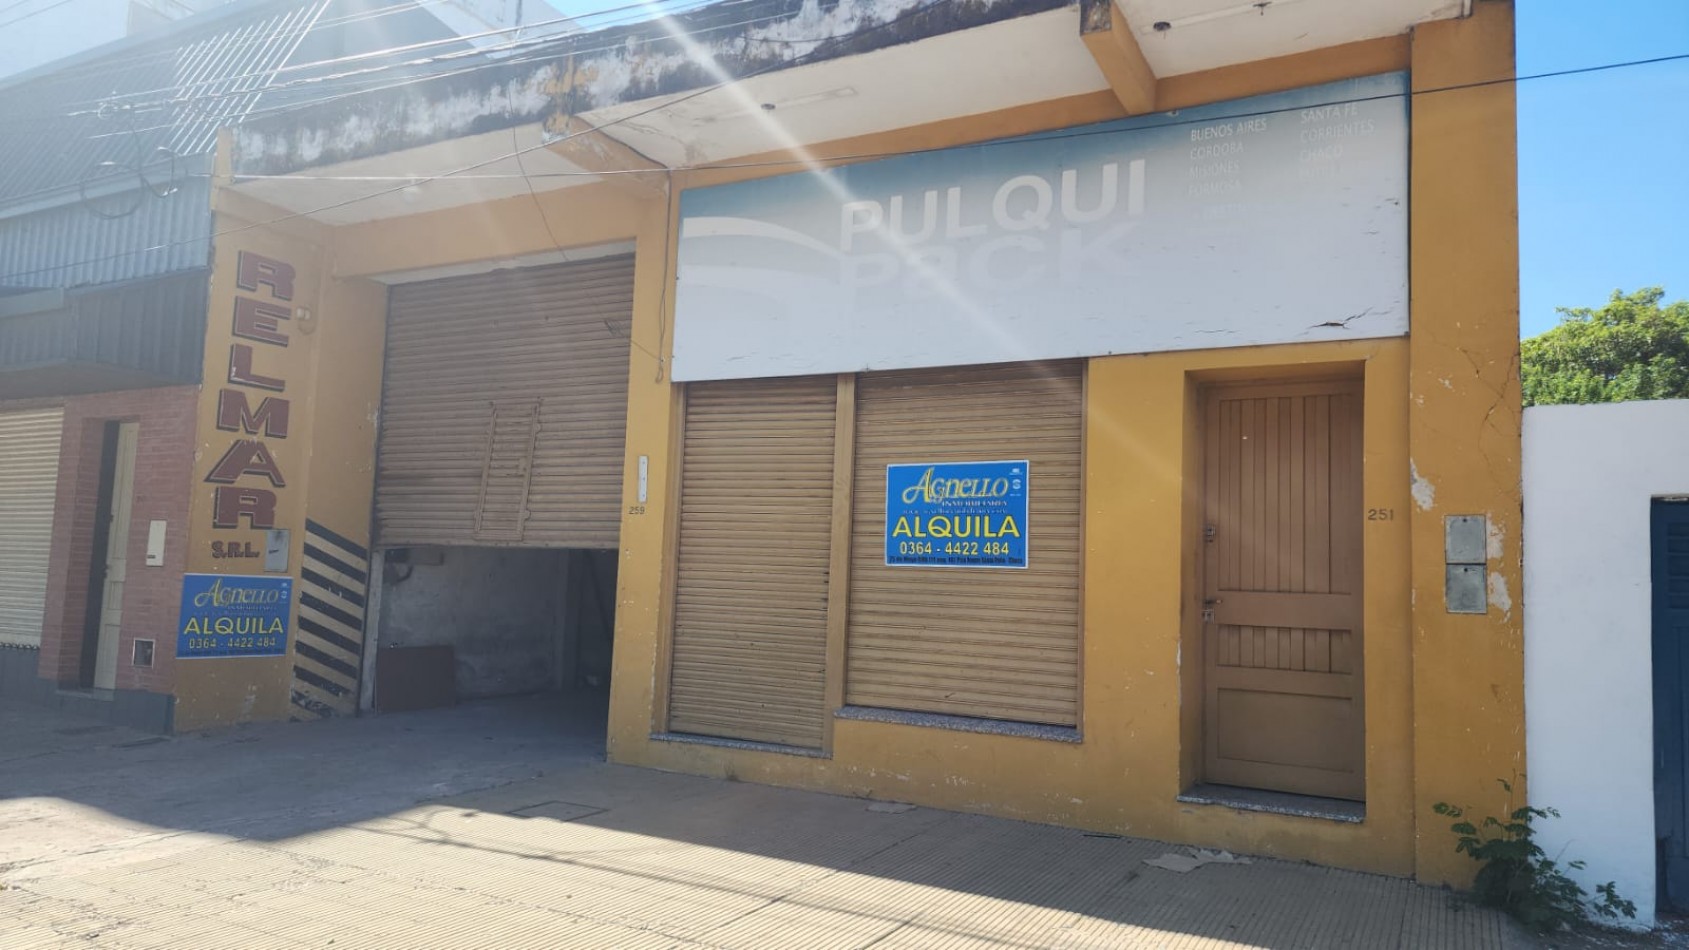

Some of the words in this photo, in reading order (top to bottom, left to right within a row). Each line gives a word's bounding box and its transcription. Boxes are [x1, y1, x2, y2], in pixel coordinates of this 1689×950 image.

[1300, 106, 1340, 124] SANTA
[1344, 103, 1358, 117] FE
[1191, 124, 1233, 142] BUENOS
[1237, 118, 1267, 135] AIRES
[1300, 119, 1375, 143] CORRIENTES
[841, 159, 1145, 250] PULQUI
[203, 249, 296, 530] RELMAR
[1368, 509, 1394, 520] 251
[892, 515, 1020, 538] ALQUILA
[900, 541, 932, 555] 0364
[945, 541, 978, 555] 4422
[983, 541, 1009, 555] 484
[183, 617, 284, 635] ALQUILA
[189, 638, 216, 649] 0364
[227, 638, 253, 648] 4422
[257, 637, 275, 648] 484
